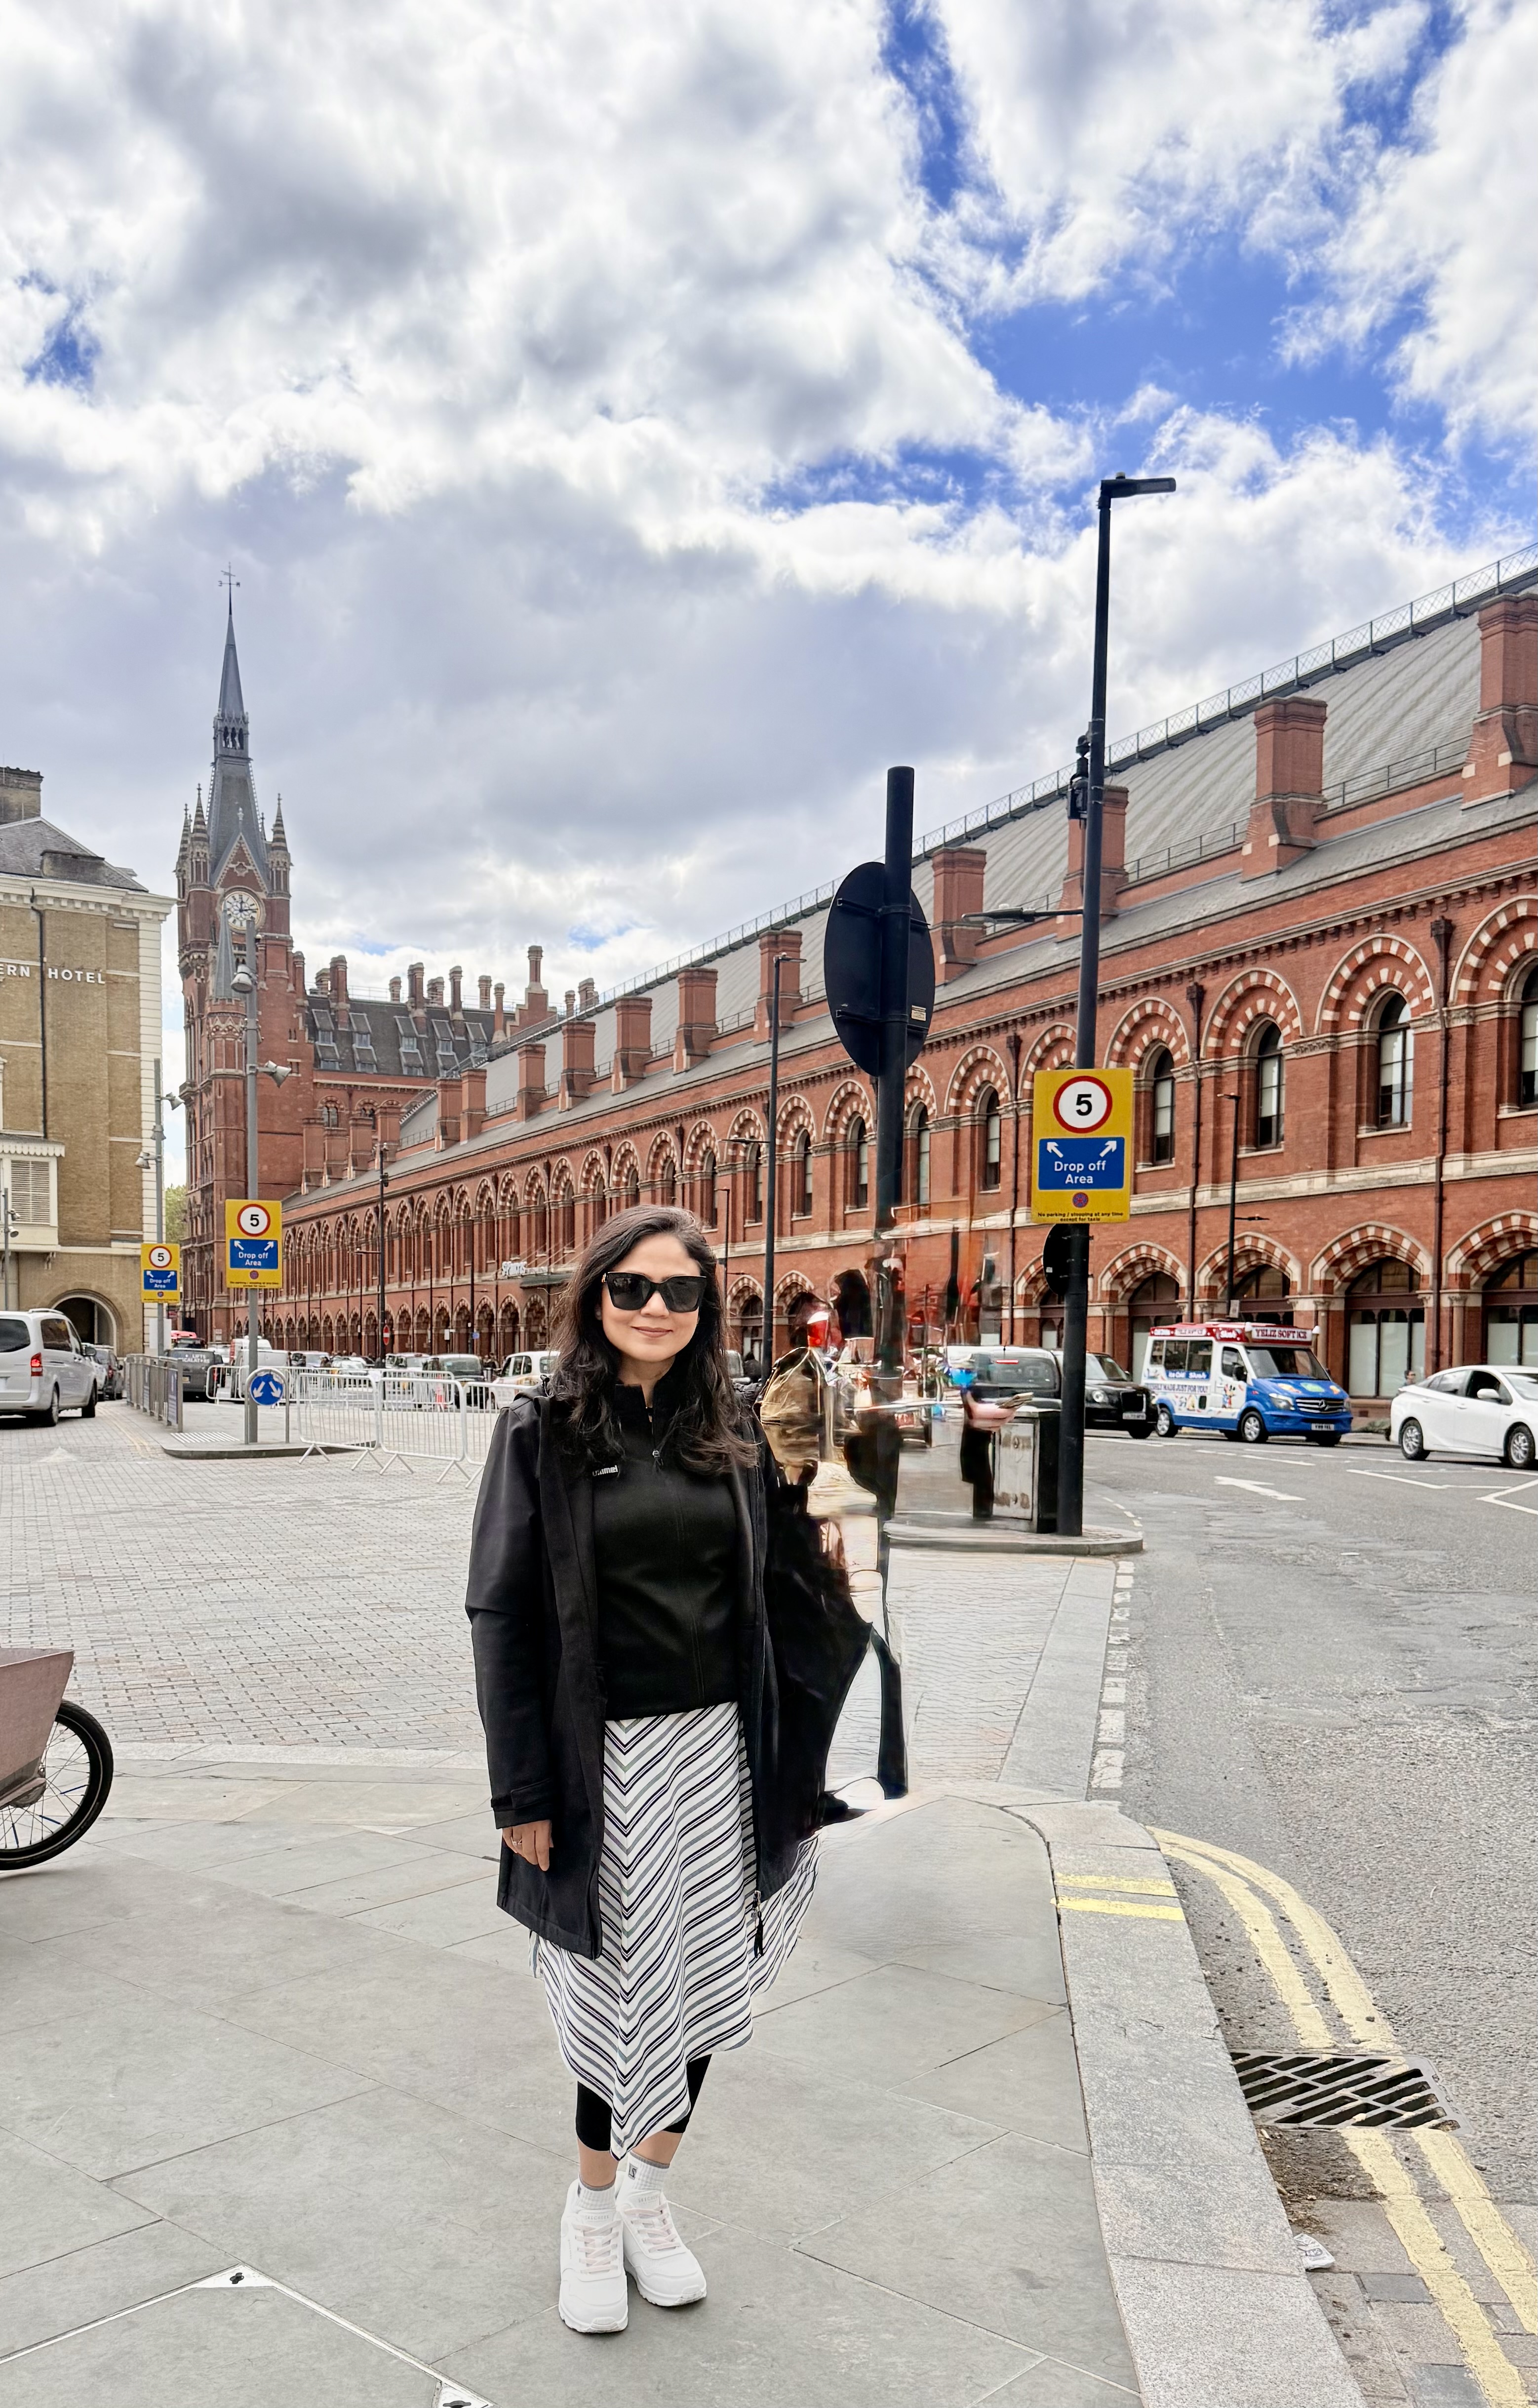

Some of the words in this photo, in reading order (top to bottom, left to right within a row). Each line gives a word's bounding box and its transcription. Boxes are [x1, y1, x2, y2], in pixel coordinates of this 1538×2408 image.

[48, 967, 105, 984] HOTEL
[1076, 1093, 1092, 1116] 5
[1054, 1161, 1084, 1173] Drop
[1088, 1160, 1106, 1171] off
[1065, 1174, 1094, 1184] Area
[250, 1214, 260, 1227] 5
[158, 1253, 164, 1261] 5
[1256, 1328, 1276, 1337] YELIZ
[1277, 1329, 1296, 1338] SOFT
[1297, 1330, 1307, 1339] ICE
